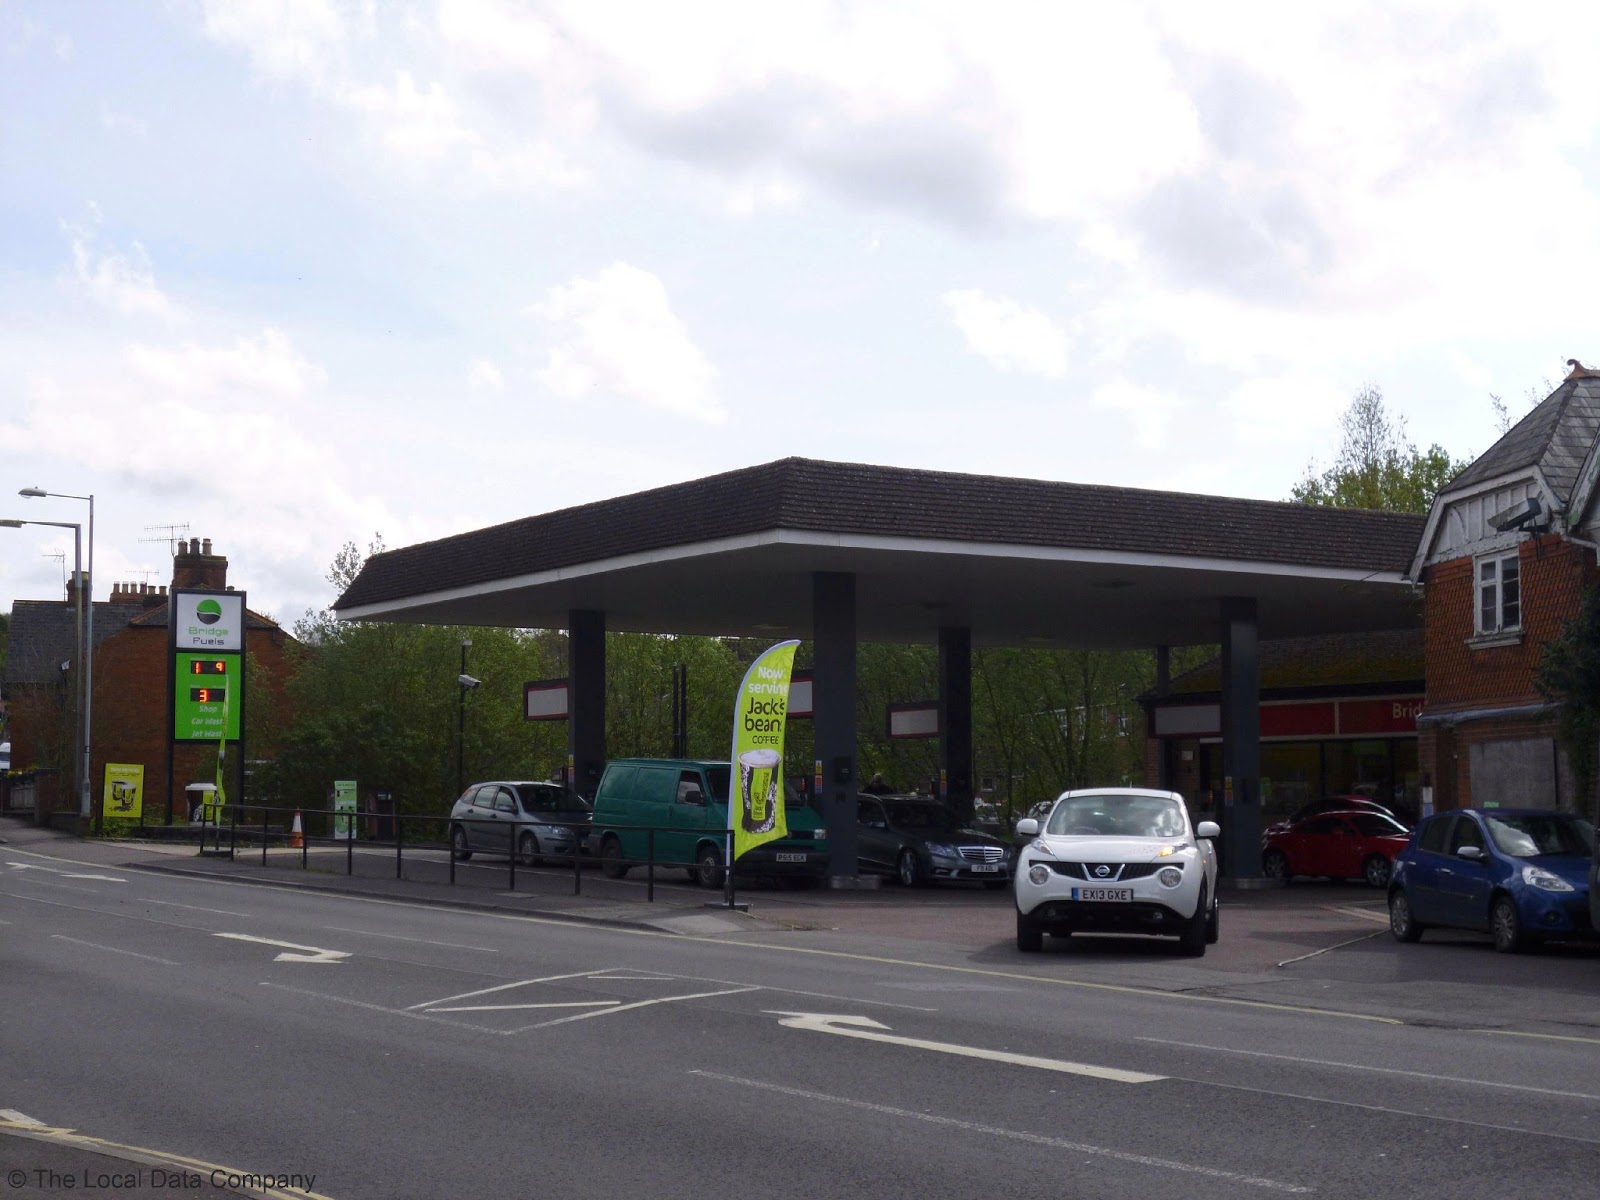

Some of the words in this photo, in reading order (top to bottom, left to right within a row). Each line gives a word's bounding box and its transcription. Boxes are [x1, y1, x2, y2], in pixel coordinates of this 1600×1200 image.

[188, 626, 229, 636] Bridge
[192, 637, 225, 645] Fuels
[758, 667, 784, 679] Now
[199, 705, 218, 713] Shop
[746, 696, 785, 715] Jack's
[191, 717, 203, 725] Car
[752, 735, 779, 745] COFFEE
[1082, 889, 1105, 900] EX13
[1107, 890, 1127, 900] GXE
